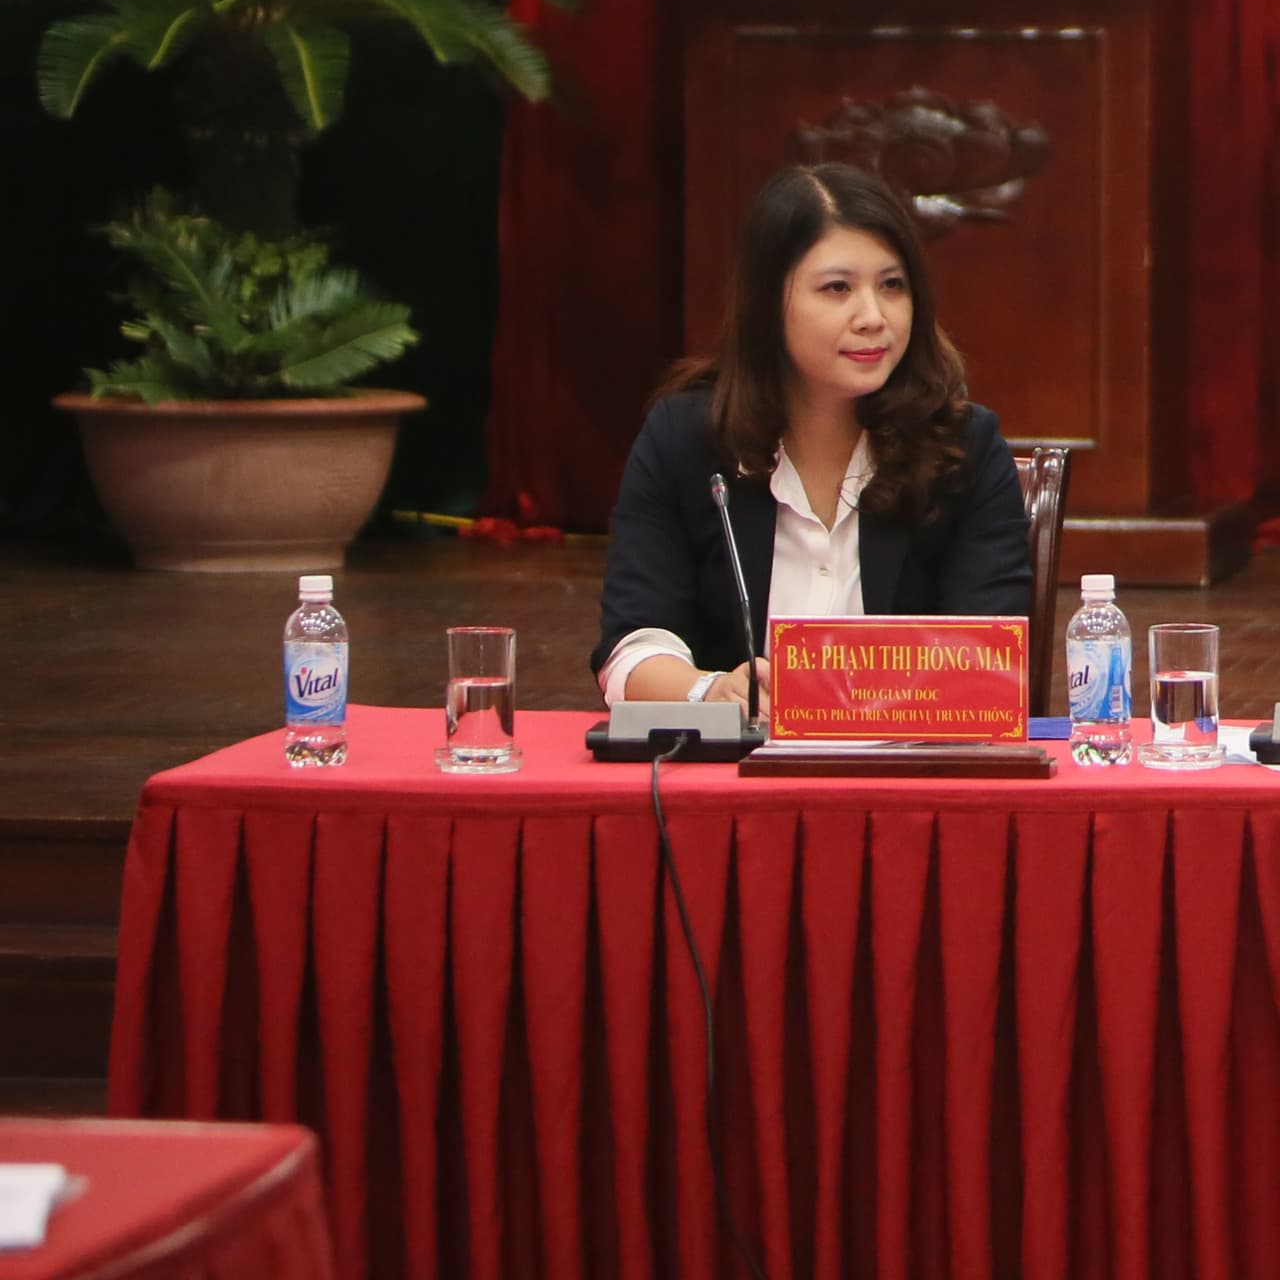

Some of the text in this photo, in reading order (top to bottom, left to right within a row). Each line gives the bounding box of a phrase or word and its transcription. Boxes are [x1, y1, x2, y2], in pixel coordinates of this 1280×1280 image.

[821, 644, 876, 677] PHẠM
[879, 644, 913, 678] THỊ
[976, 645, 1012, 671] MAI
[1069, 664, 1090, 690] tal
[294, 666, 340, 699] Vital
